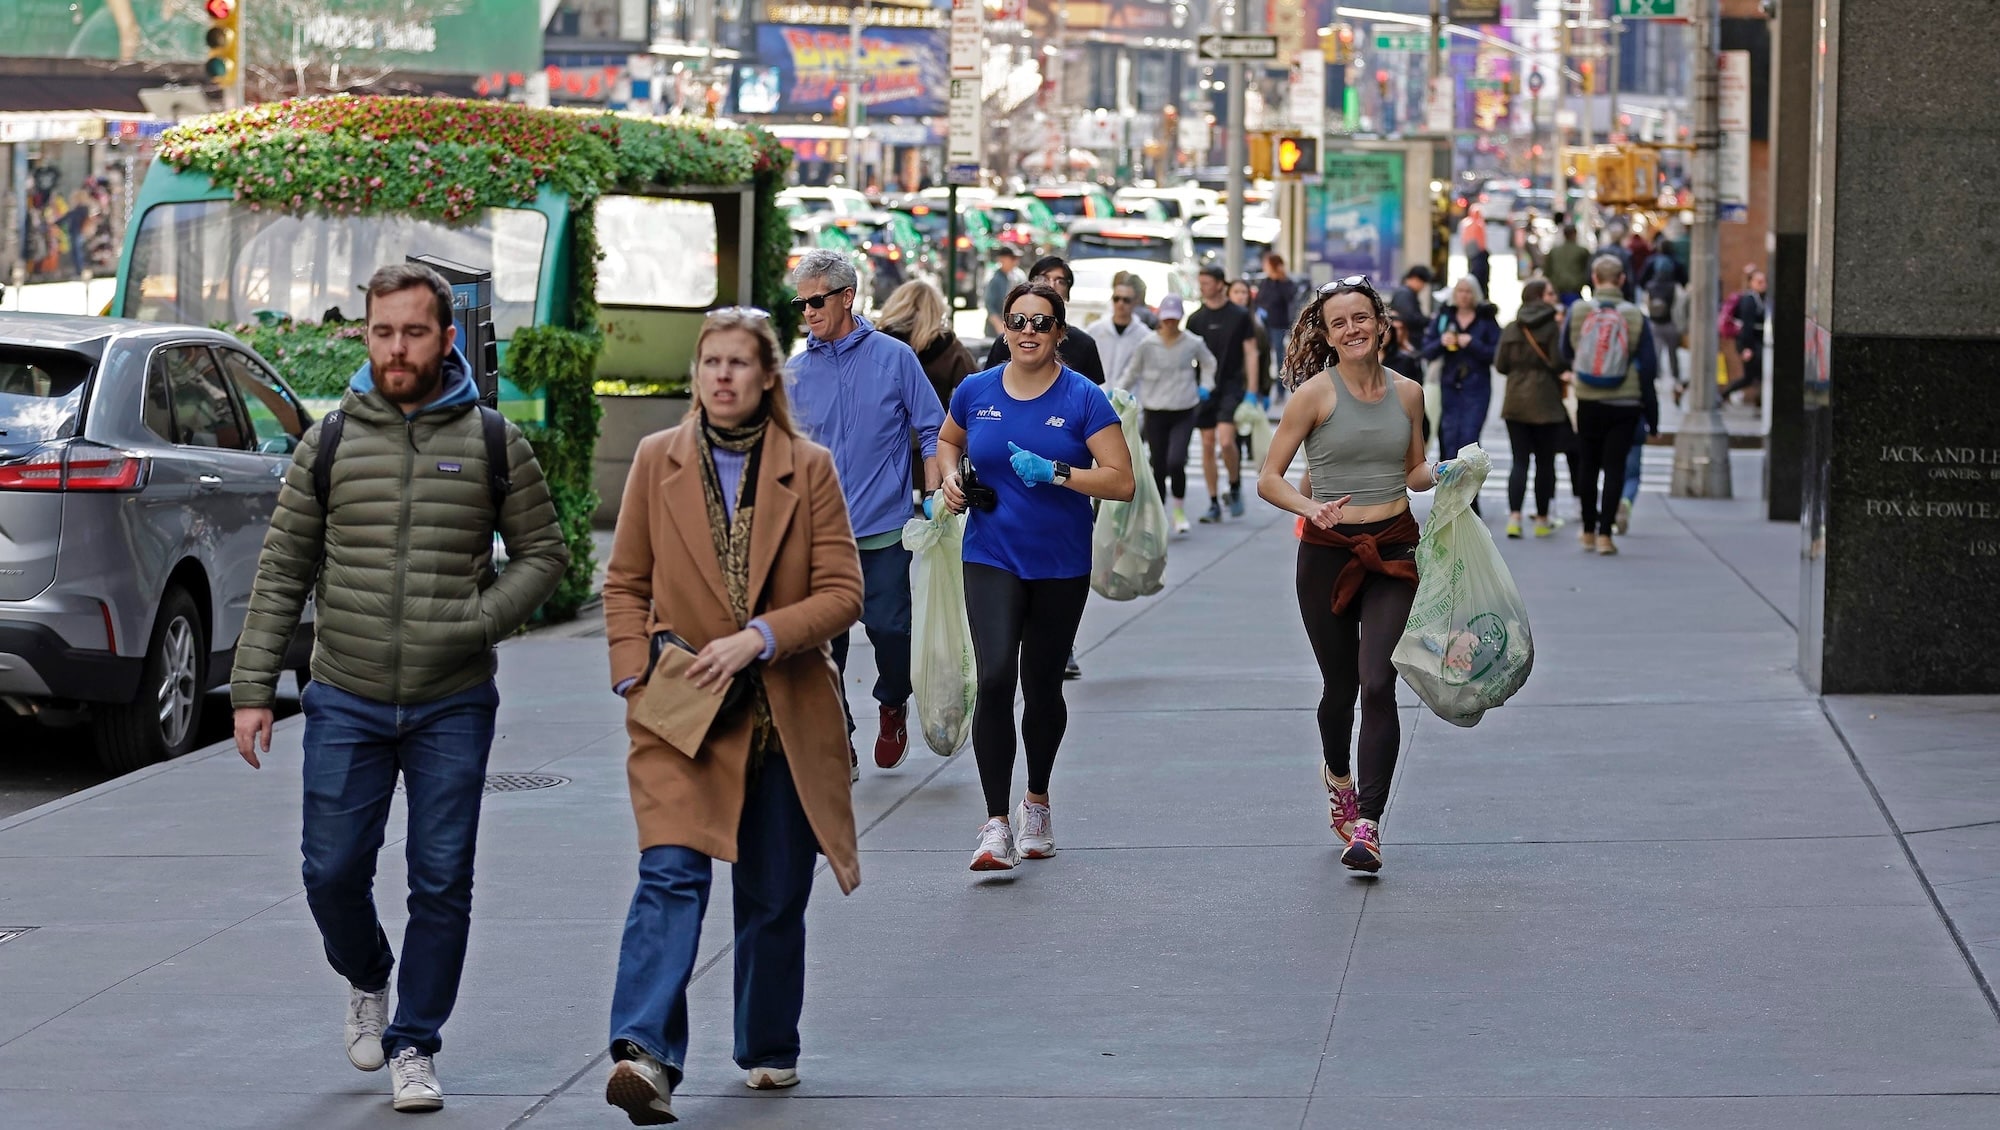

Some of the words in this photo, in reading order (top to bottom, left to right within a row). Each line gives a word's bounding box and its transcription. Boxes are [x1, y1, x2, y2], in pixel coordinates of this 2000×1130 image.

[1880, 446, 1924, 462] JACK
[1930, 447, 1976, 463] AND
[1928, 468, 1981, 479] OWNERS
[1866, 500, 1902, 516] FOX
[1907, 501, 1920, 517] &
[1926, 502, 1991, 518] FOWLE
[1969, 541, 2000, 556] 198
